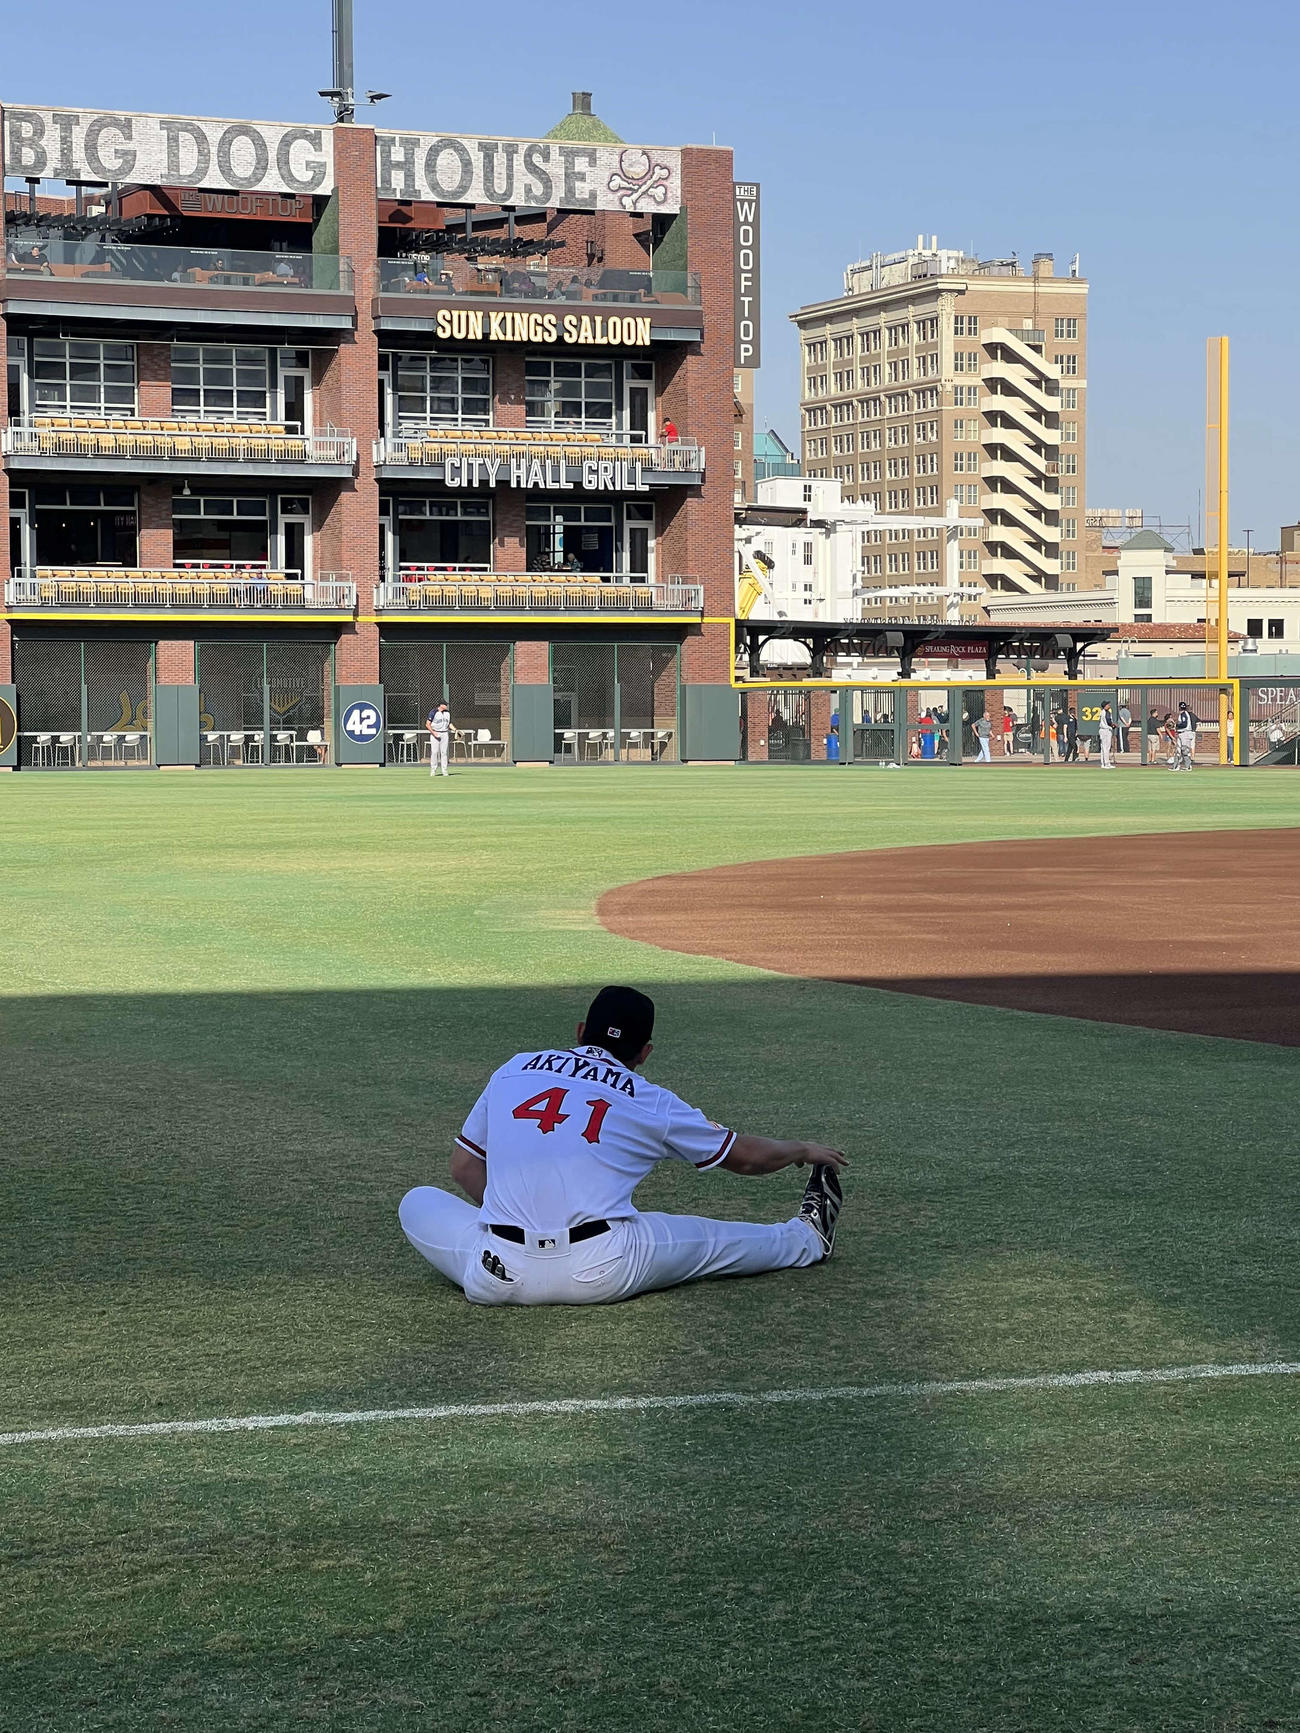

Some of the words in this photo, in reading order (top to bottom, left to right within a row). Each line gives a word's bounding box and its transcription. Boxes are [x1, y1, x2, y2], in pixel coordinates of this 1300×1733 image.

[4, 110, 137, 182] BIG
[160, 119, 327, 193] DOG
[376, 134, 598, 208] HOUSE
[181, 191, 200, 200] THE
[205, 193, 305, 217] WOOFTOP
[736, 186, 756, 196] THE
[736, 201, 757, 366] WOOFTOP
[436, 309, 484, 341] SUN
[489, 311, 558, 343] KINGS
[563, 313, 652, 346] SALOON
[444, 457, 500, 489] CITY
[510, 459, 574, 490] HALL
[582, 460, 650, 491] GRILL
[967, 646, 987, 654] PLAZA
[1258, 687, 1300, 705] SPEA
[346, 709, 377, 735] 42
[1081, 706, 1112, 722] 32
[521, 1052, 636, 1098] AKIYAMA
[512, 1086, 613, 1144] 41
